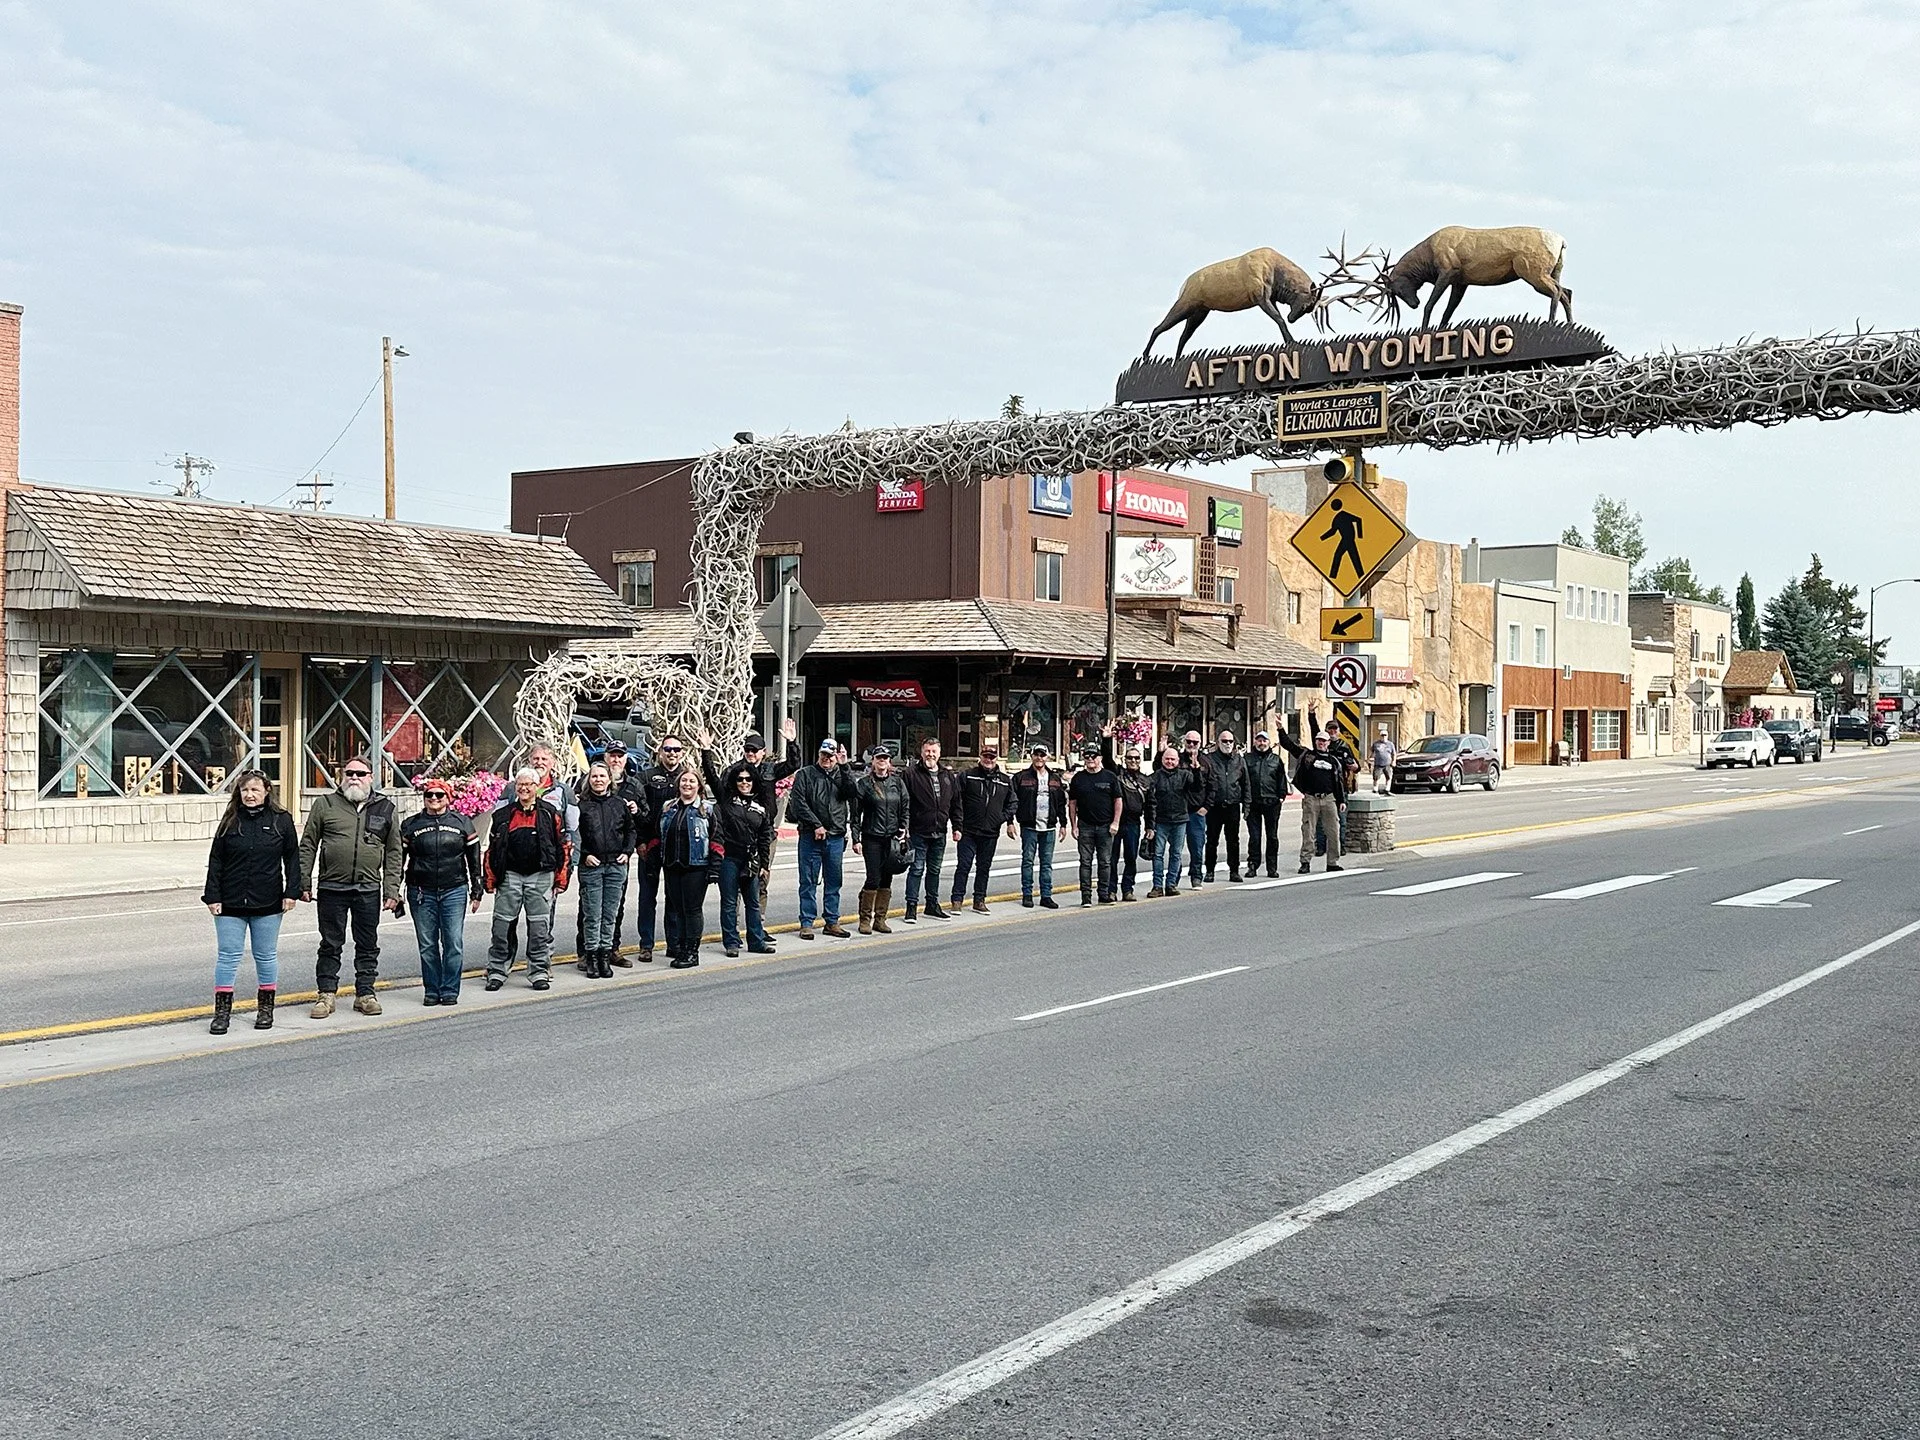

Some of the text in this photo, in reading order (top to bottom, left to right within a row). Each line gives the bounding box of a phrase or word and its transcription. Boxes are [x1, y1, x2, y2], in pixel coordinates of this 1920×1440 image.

[1184, 324, 1514, 388] AFTON WYOMING
[1290, 395, 1374, 412] World's Largest
[1284, 408, 1379, 432] ELKHORN ARCH
[879, 491, 918, 500] HONDA
[878, 499, 918, 508] SERVICE
[1125, 491, 1188, 520] HONDA
[1376, 669, 1407, 680] HEATRE
[856, 686, 917, 698] TRAXXAS
